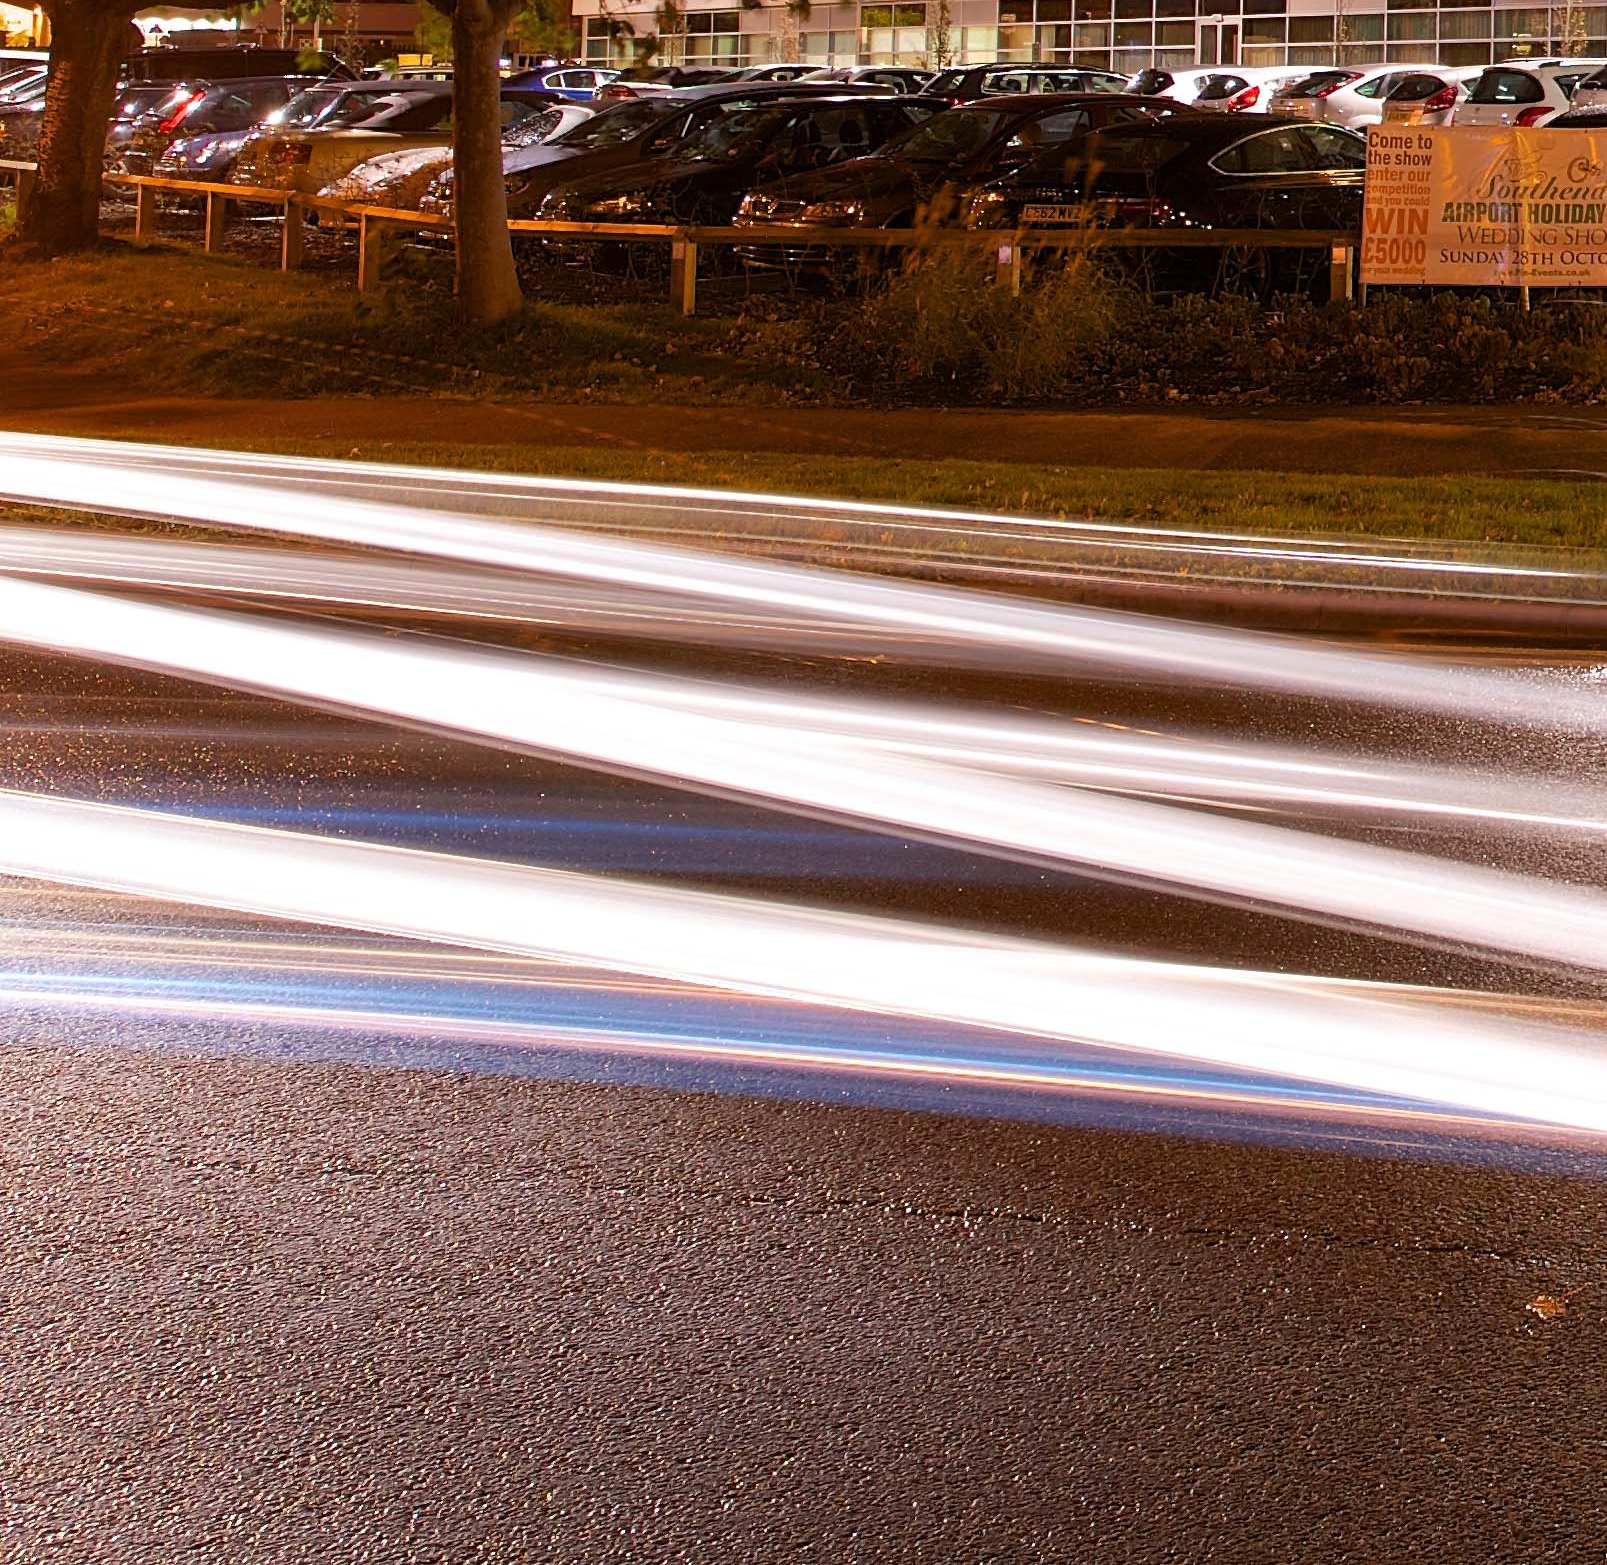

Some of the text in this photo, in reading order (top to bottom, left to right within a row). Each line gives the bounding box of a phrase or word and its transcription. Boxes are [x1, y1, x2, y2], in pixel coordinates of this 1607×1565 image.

[1369, 132, 1433, 149] Come to
[1367, 150, 1433, 166] the show
[1366, 168, 1432, 182] enter our
[1366, 183, 1431, 196] competition
[1365, 208, 1429, 235] WIN
[1441, 202, 1523, 223] AIRPORT
[1528, 203, 1607, 224] HOLIDAY
[1457, 225, 1558, 246] WEDDING
[1362, 237, 1426, 265] £5000
[1511, 250, 1553, 265] 28TH
